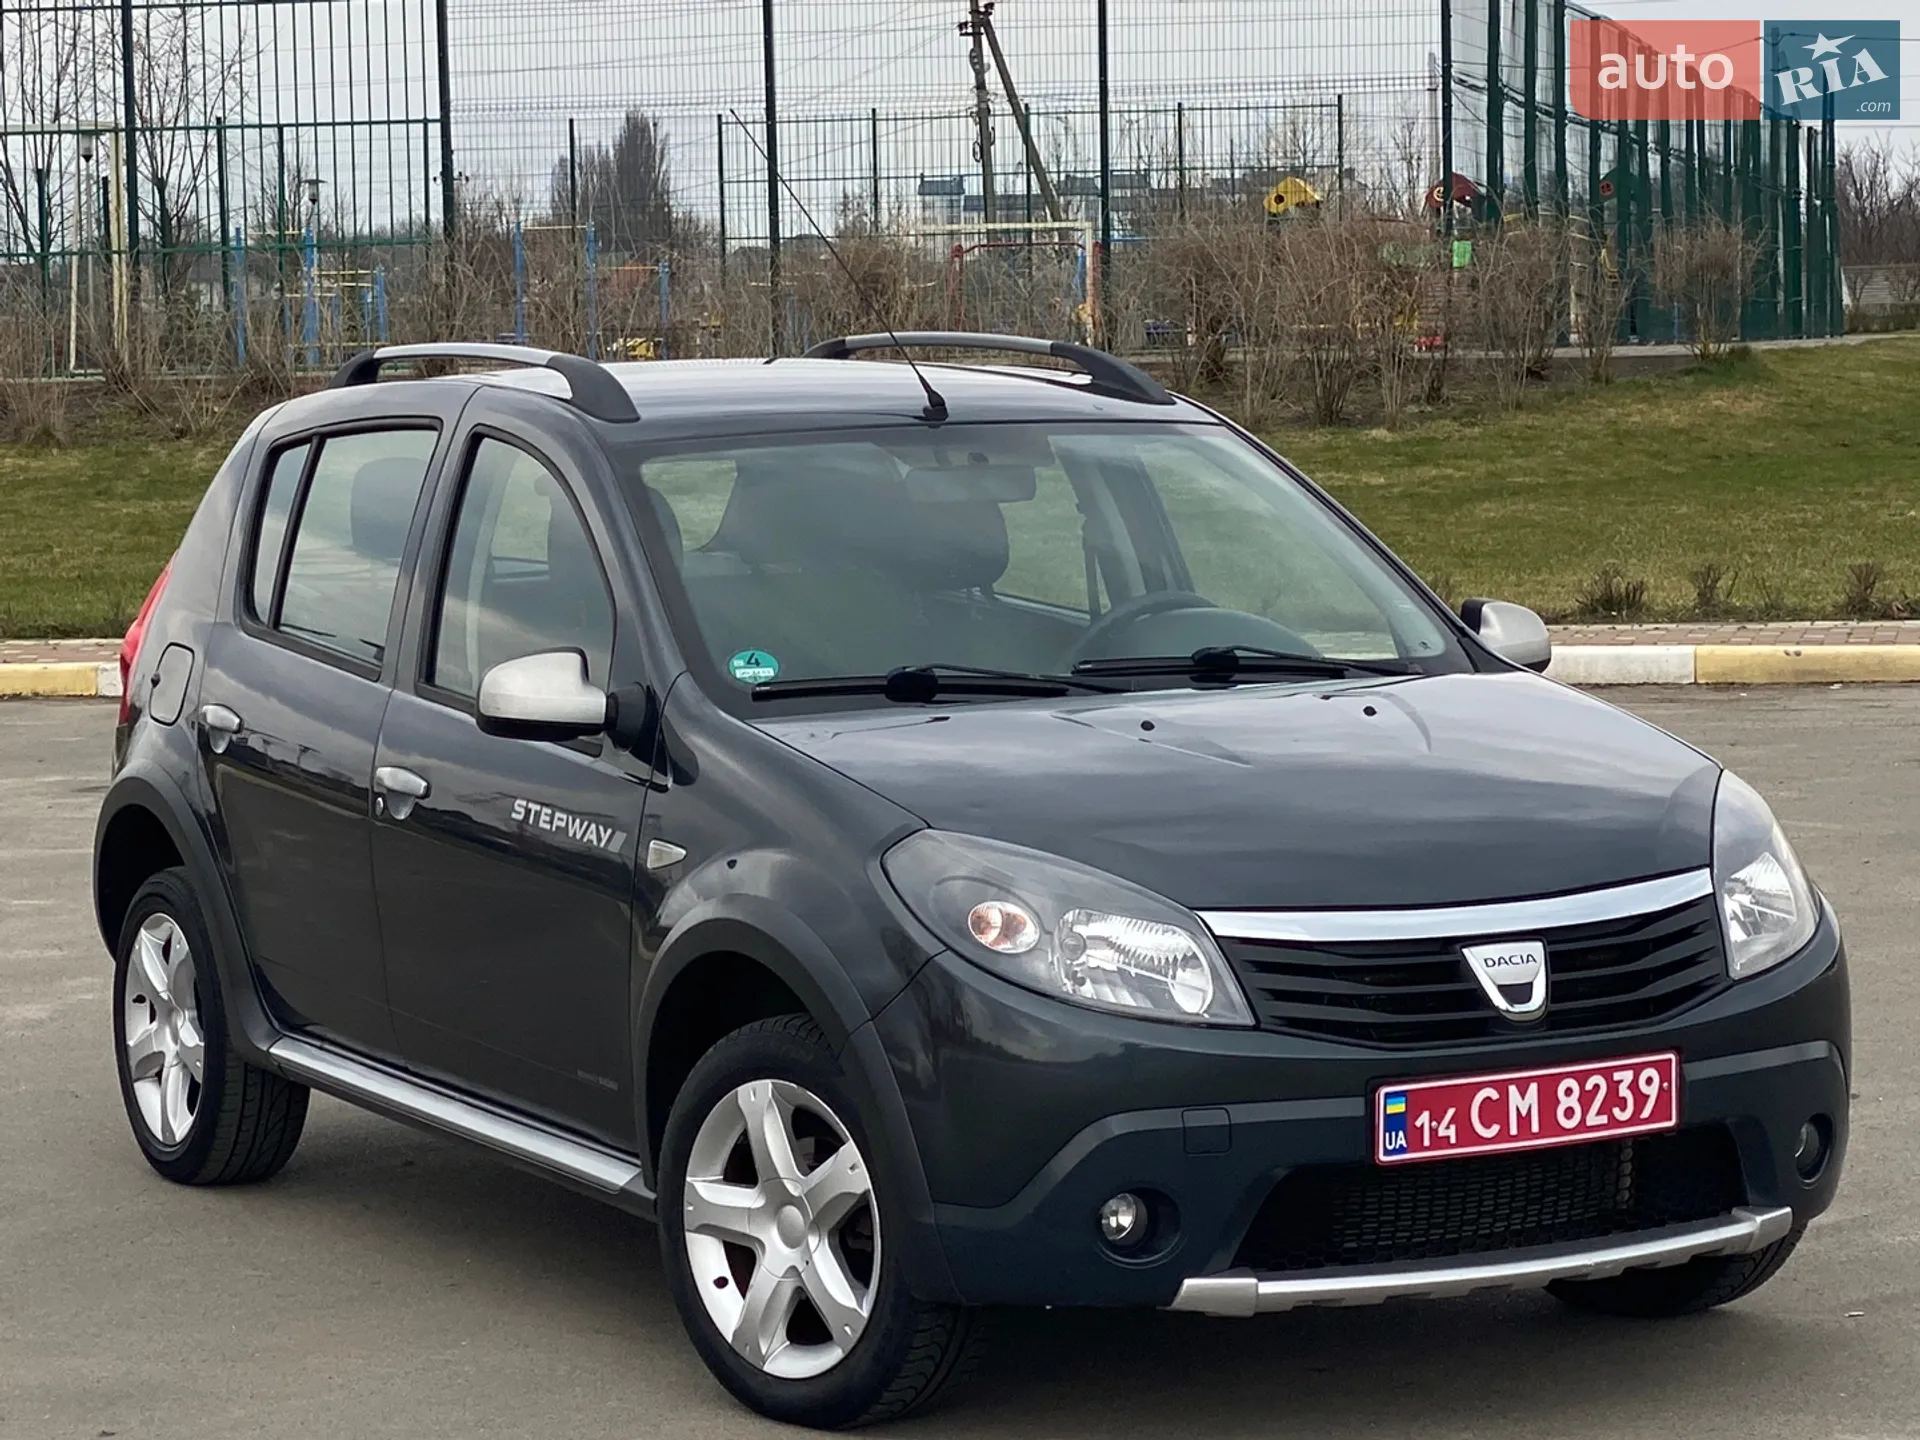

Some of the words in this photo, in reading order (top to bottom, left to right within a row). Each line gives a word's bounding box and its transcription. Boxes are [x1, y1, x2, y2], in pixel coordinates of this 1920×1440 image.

[746, 652, 761, 667] 4
[511, 798, 613, 848] STEPWAY
[1483, 953, 1538, 968] DACIA
[1414, 1107, 1457, 1147] 14
[1470, 1081, 1540, 1139] CM
[1556, 1067, 1661, 1130] 8239
[1385, 1130, 1408, 1150] UA
